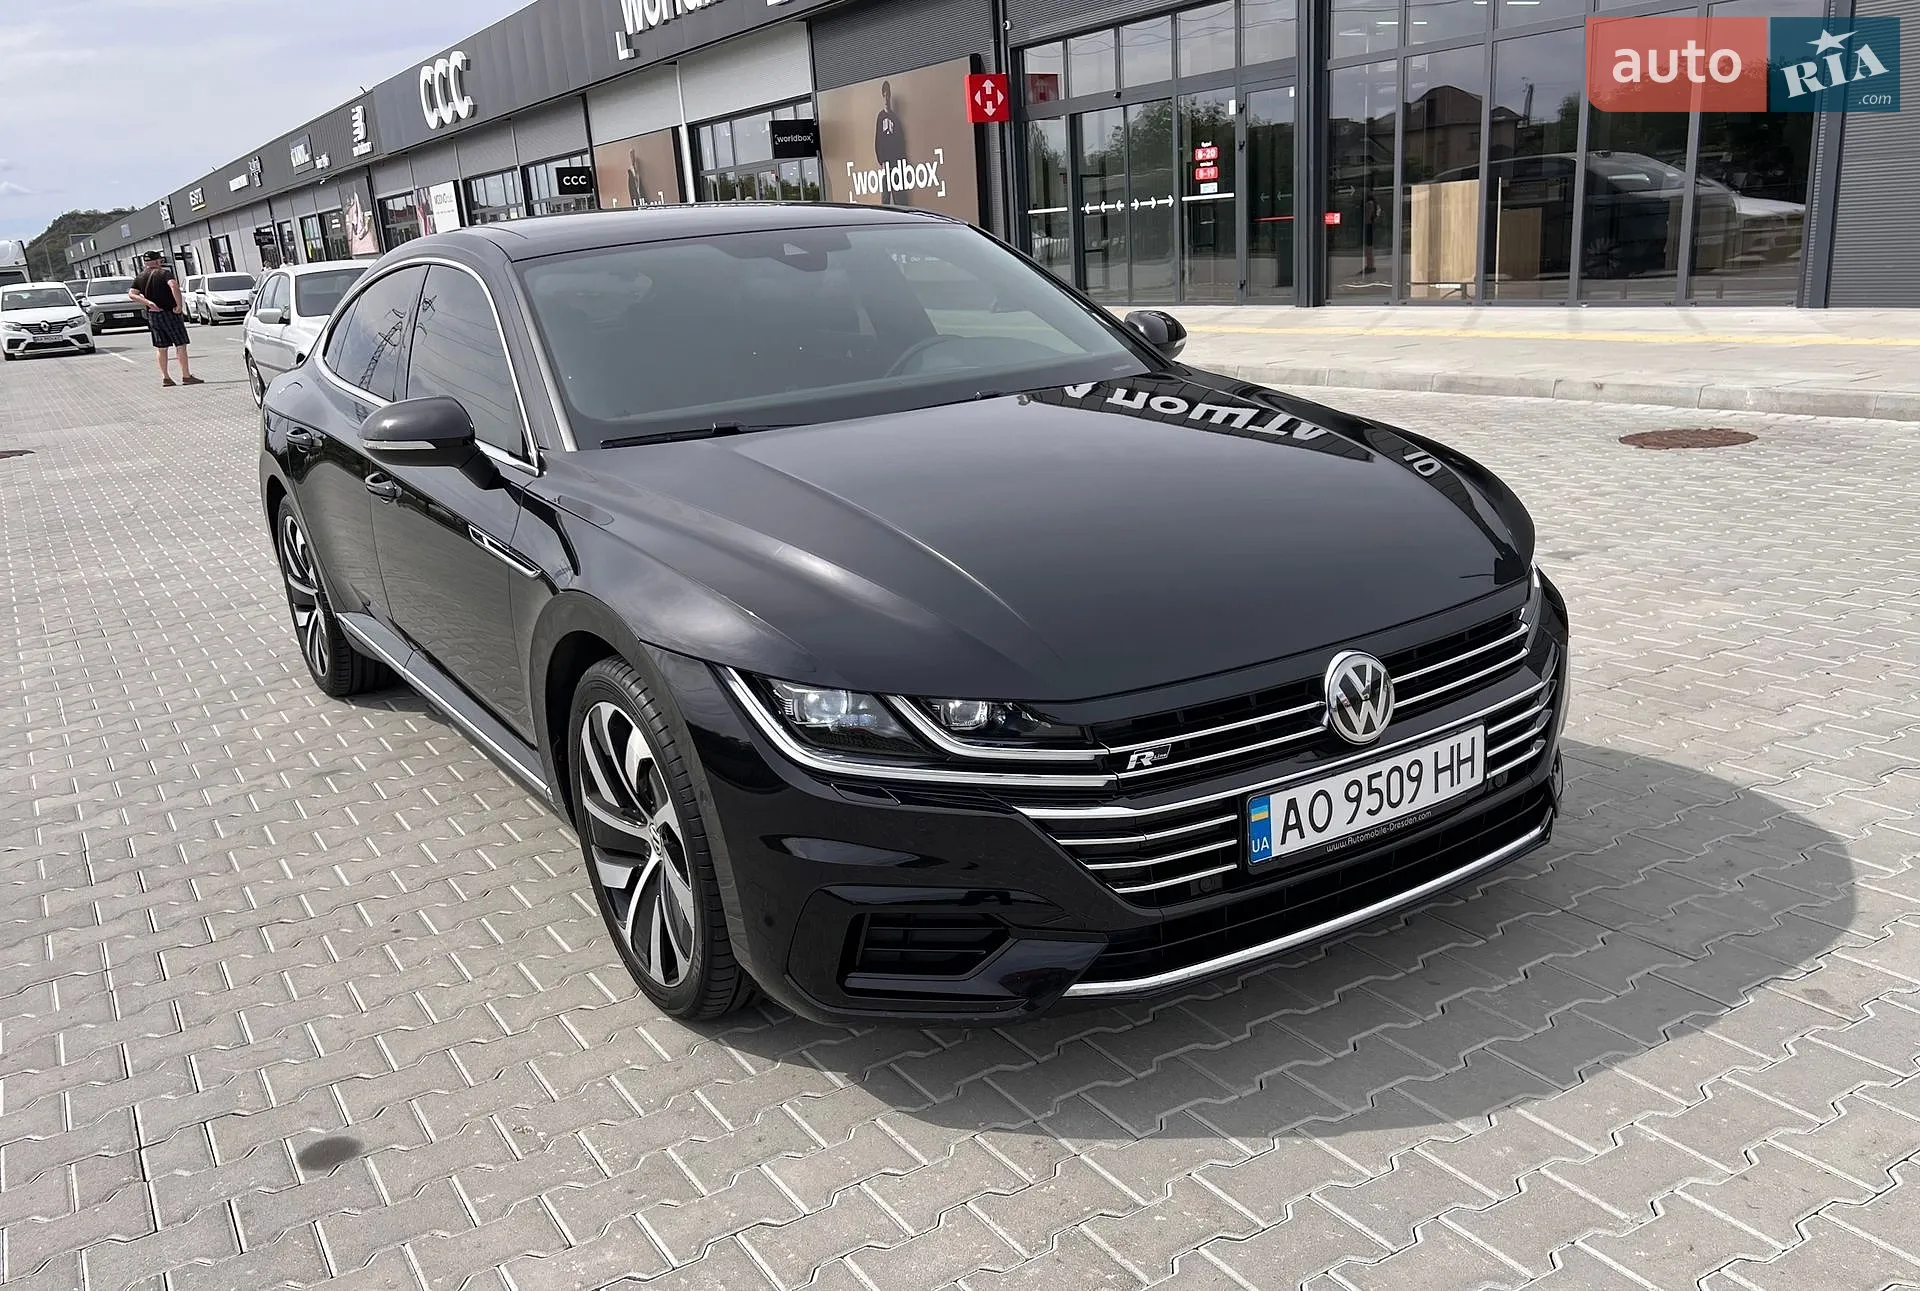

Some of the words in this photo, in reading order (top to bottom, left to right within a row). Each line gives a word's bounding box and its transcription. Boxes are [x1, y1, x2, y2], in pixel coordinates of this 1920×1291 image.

[419, 50, 474, 130] CCC
[776, 133, 812, 144] worldbox
[562, 175, 587, 186] CCC
[853, 158, 940, 196] worldbox
[1280, 789, 1333, 846] AO
[1343, 758, 1424, 826] 9509
[1433, 736, 1476, 794] HH
[1252, 839, 1271, 853] UA
[1326, 810, 1432, 852] www.Automobile-Dresden.com
